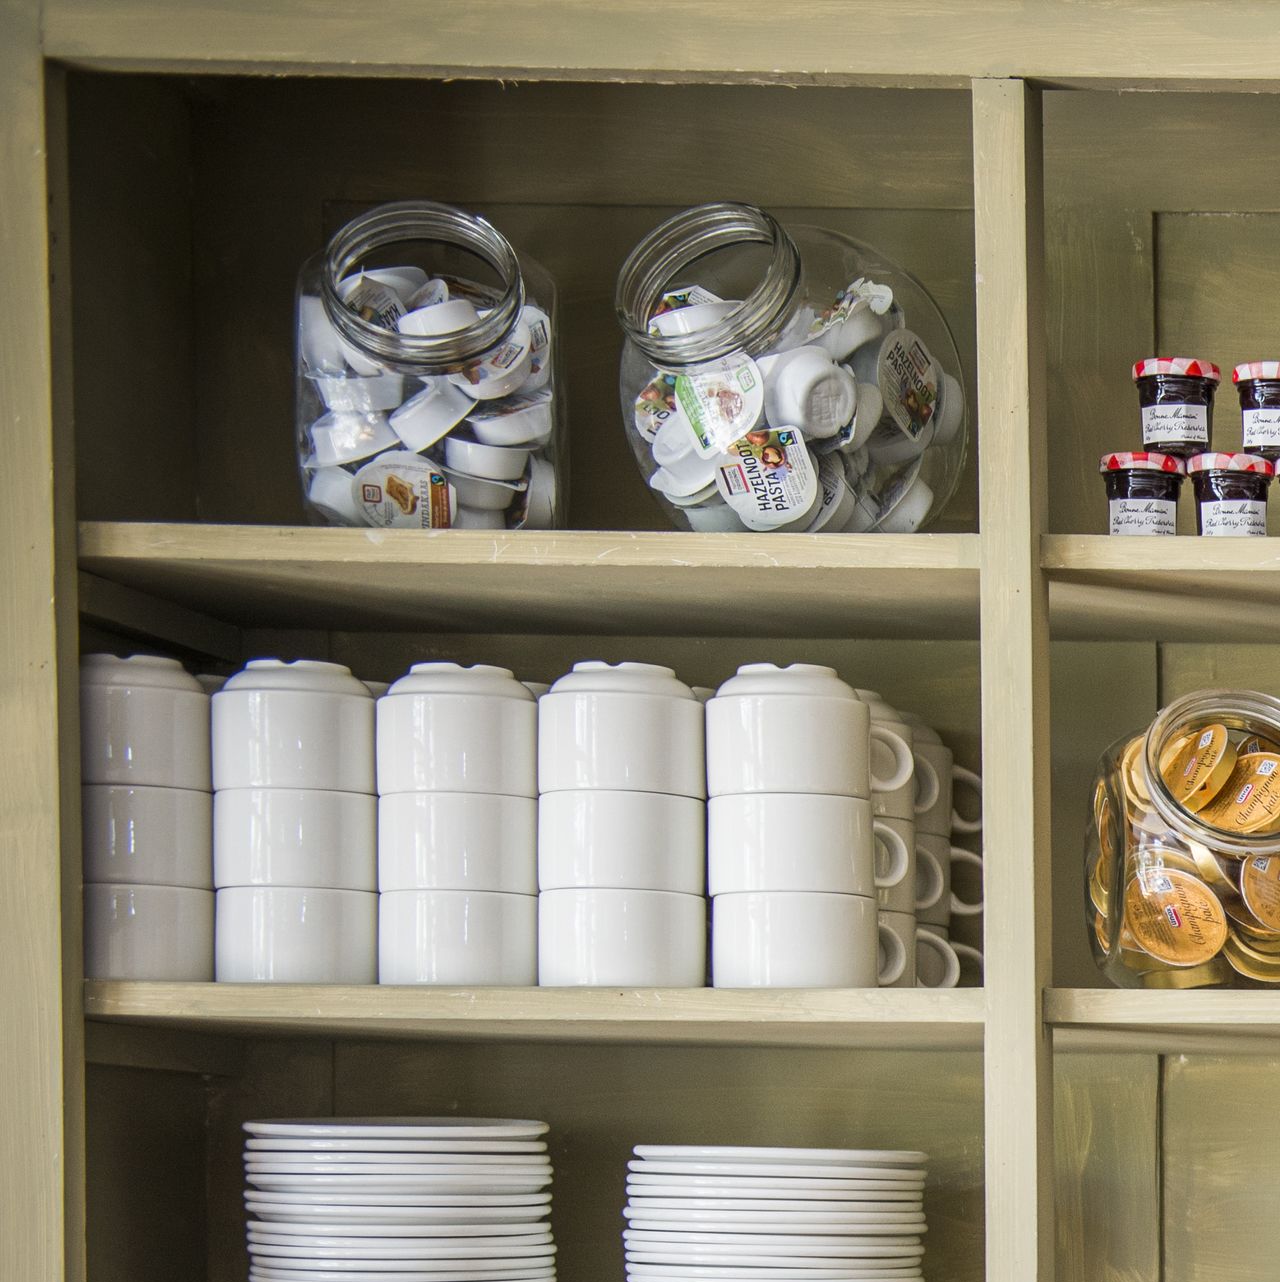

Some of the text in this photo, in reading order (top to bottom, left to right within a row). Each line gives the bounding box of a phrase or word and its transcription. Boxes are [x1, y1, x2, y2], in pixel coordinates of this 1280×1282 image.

[886, 350, 910, 389] PASTA
[892, 341, 933, 402] HAZELNOOT
[738, 443, 771, 512] HAZELNOOT
[767, 471, 790, 512] PASTA
[1236, 769, 1279, 826] Champignon
[1165, 905, 1178, 927] unox
[1175, 882, 1207, 946] Champignon
